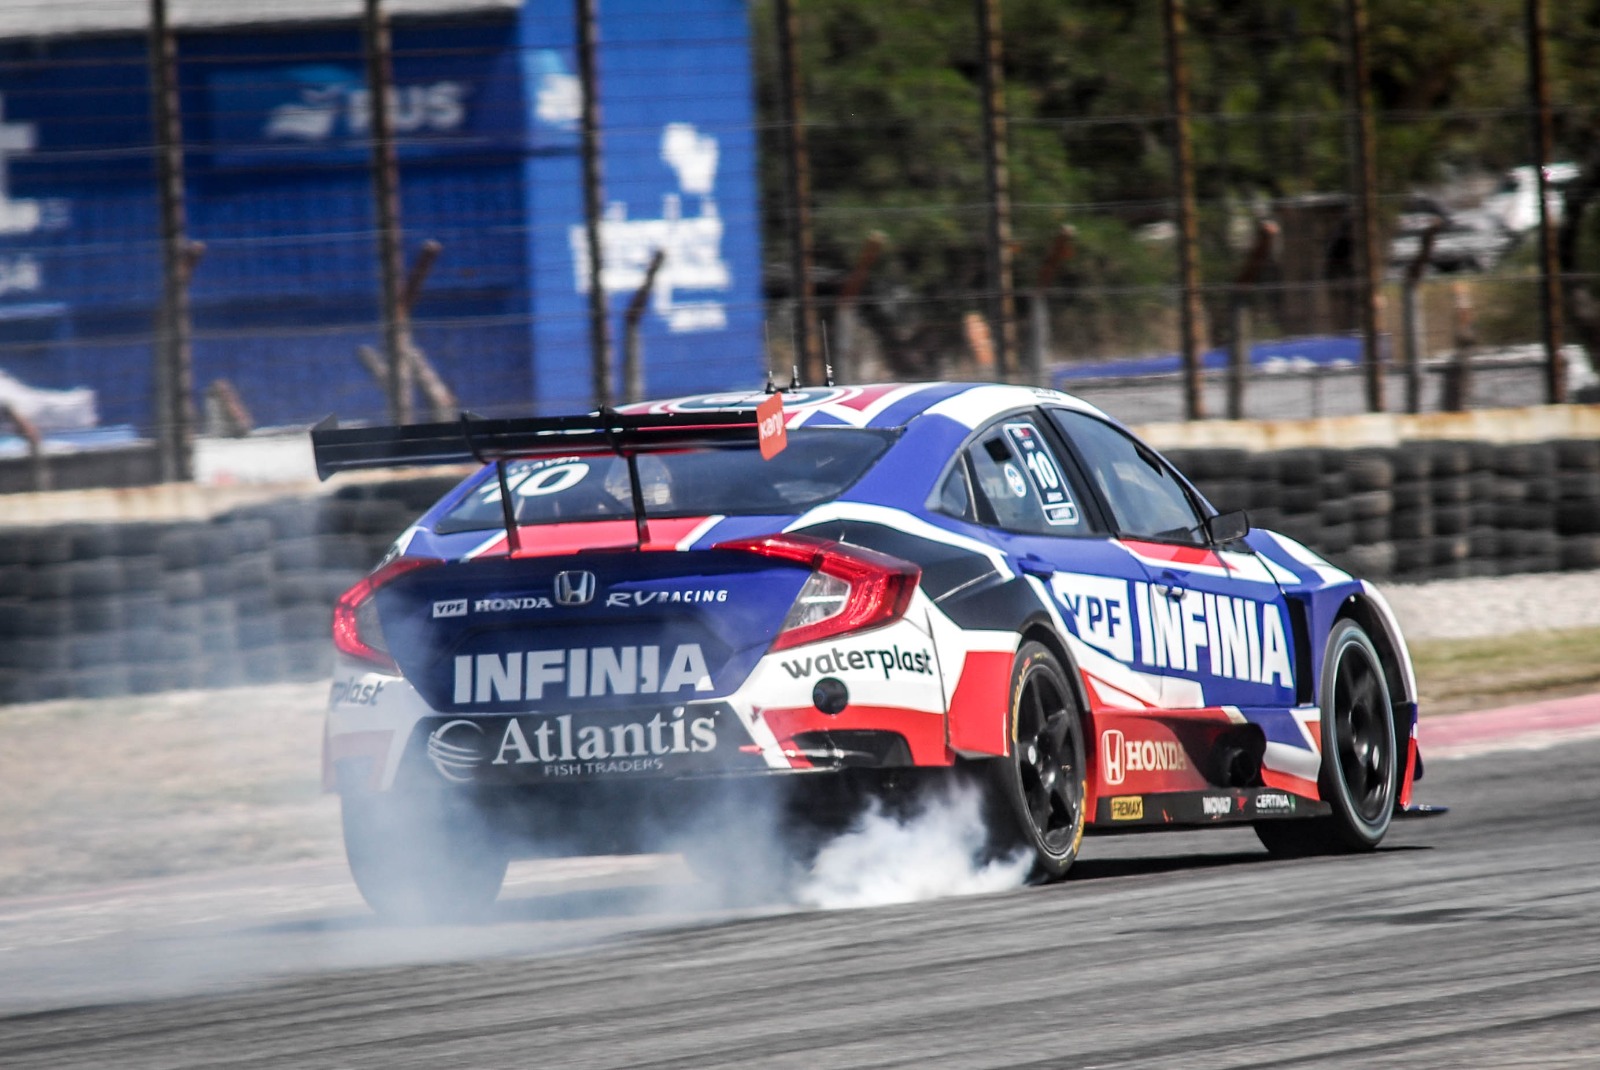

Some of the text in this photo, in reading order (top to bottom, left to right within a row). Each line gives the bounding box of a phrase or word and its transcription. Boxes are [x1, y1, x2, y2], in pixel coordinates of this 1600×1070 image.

[479, 462, 590, 504] 10
[1027, 451, 1059, 490] 10
[436, 597, 553, 615] YPF HONDA
[658, 589, 729, 604] RACING
[1063, 581, 1295, 689] YPF INFINIA
[454, 643, 715, 704] INFINIA
[781, 644, 933, 680] waterplast
[492, 706, 718, 765] Atlantis
[544, 757, 664, 777] FISH TRADERS
[1125, 740, 1188, 771] HONDA
[1113, 800, 1143, 816] FREMAX
[1255, 794, 1290, 808] CERTINA
